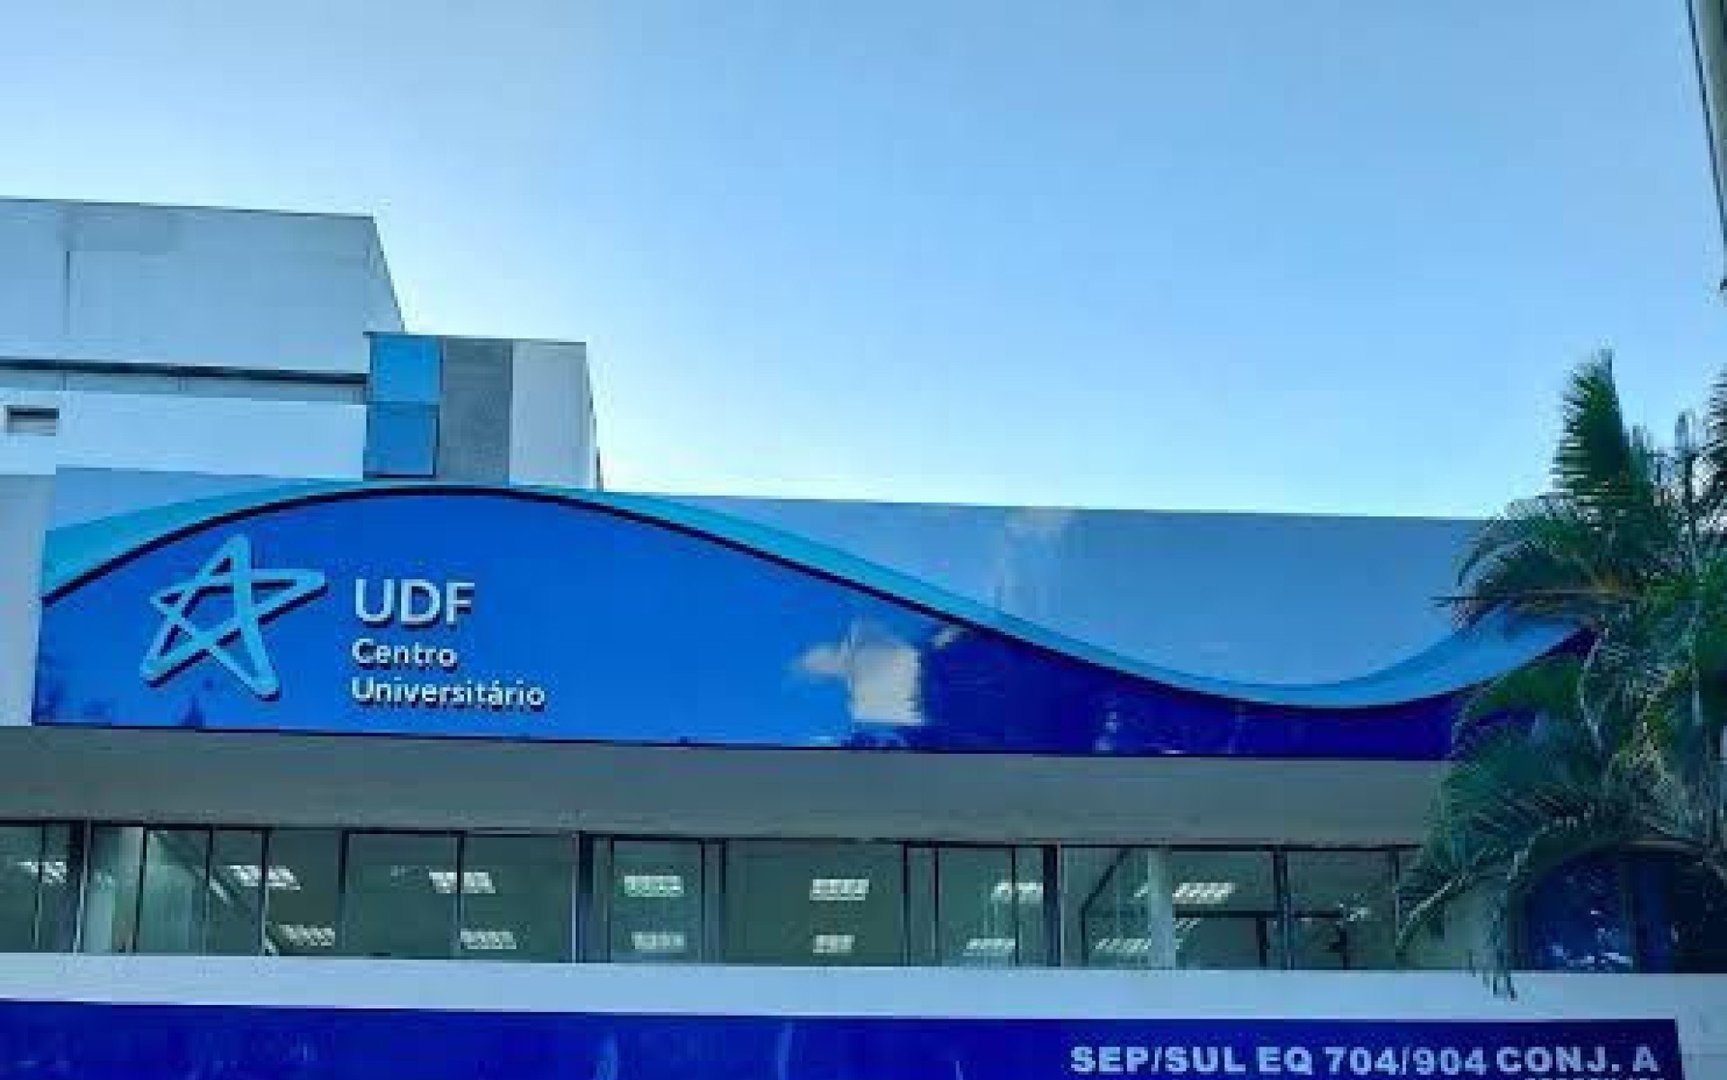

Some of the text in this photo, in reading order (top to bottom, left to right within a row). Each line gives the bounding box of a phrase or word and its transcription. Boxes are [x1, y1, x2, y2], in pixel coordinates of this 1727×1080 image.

[354, 578, 475, 626] UDF
[351, 638, 458, 668] Centro
[351, 676, 546, 708] Universitário
[1070, 1046, 1660, 1076] SEP/SUL EQ 704/904 CONJ. A
